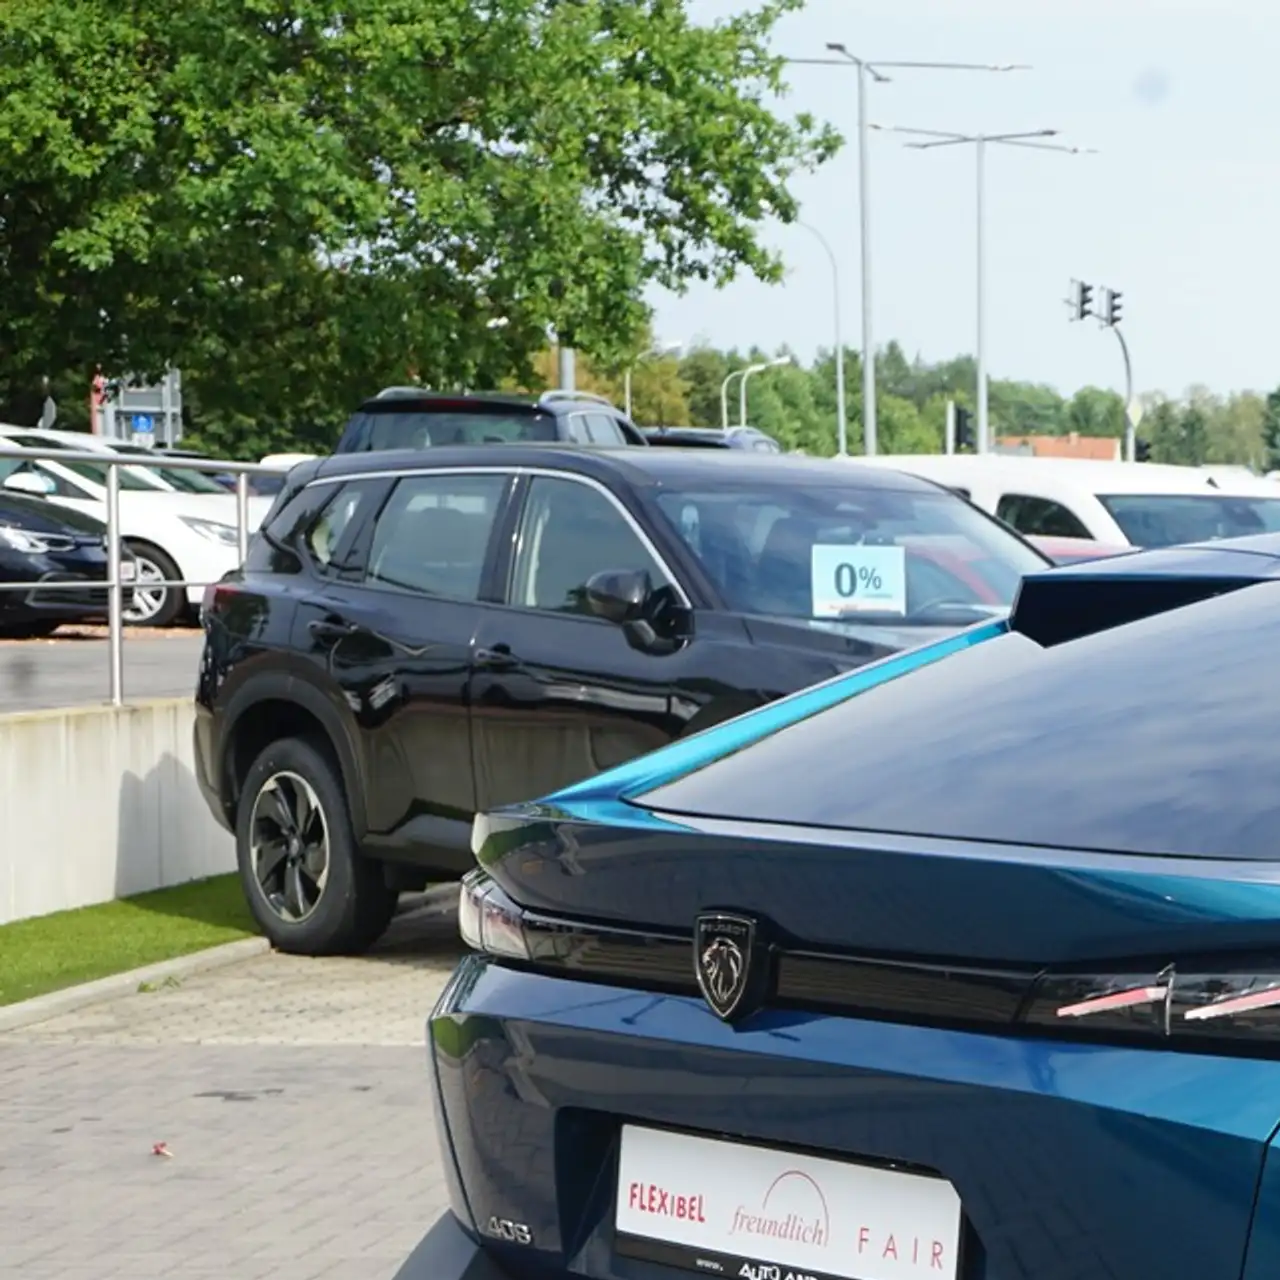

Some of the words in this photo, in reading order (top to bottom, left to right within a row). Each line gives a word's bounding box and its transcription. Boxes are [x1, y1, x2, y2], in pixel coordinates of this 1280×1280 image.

[834, 562, 882, 598] 0%
[629, 1182, 706, 1224] FLEXIBEL
[728, 1205, 824, 1246] freundlich
